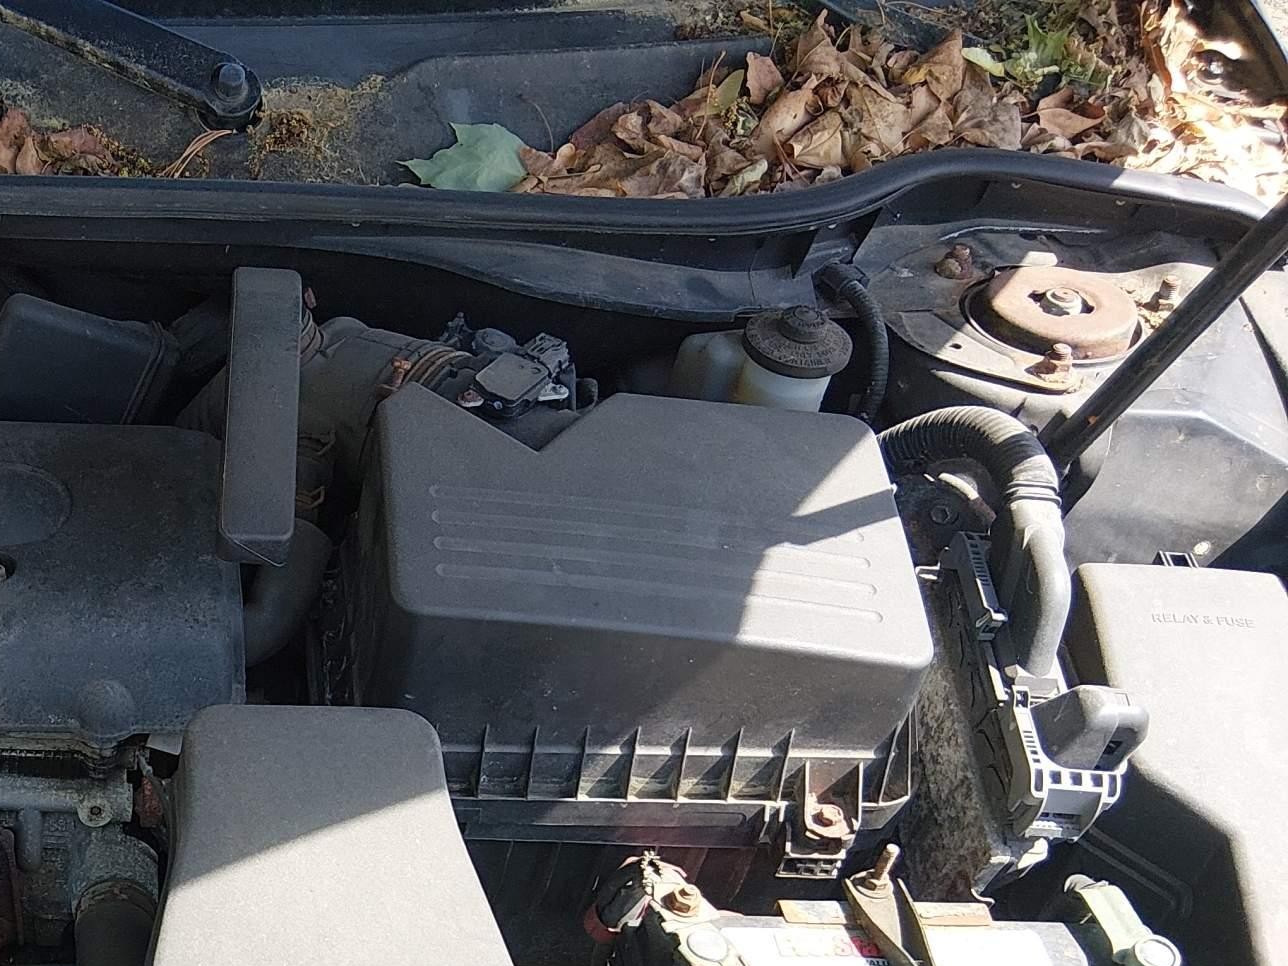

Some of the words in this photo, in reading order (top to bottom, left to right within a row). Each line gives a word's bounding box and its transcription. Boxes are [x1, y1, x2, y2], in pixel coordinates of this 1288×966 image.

[1151, 612, 1200, 624] RELAY
[1202, 615, 1214, 625] &
[1215, 615, 1257, 629] FUSE
